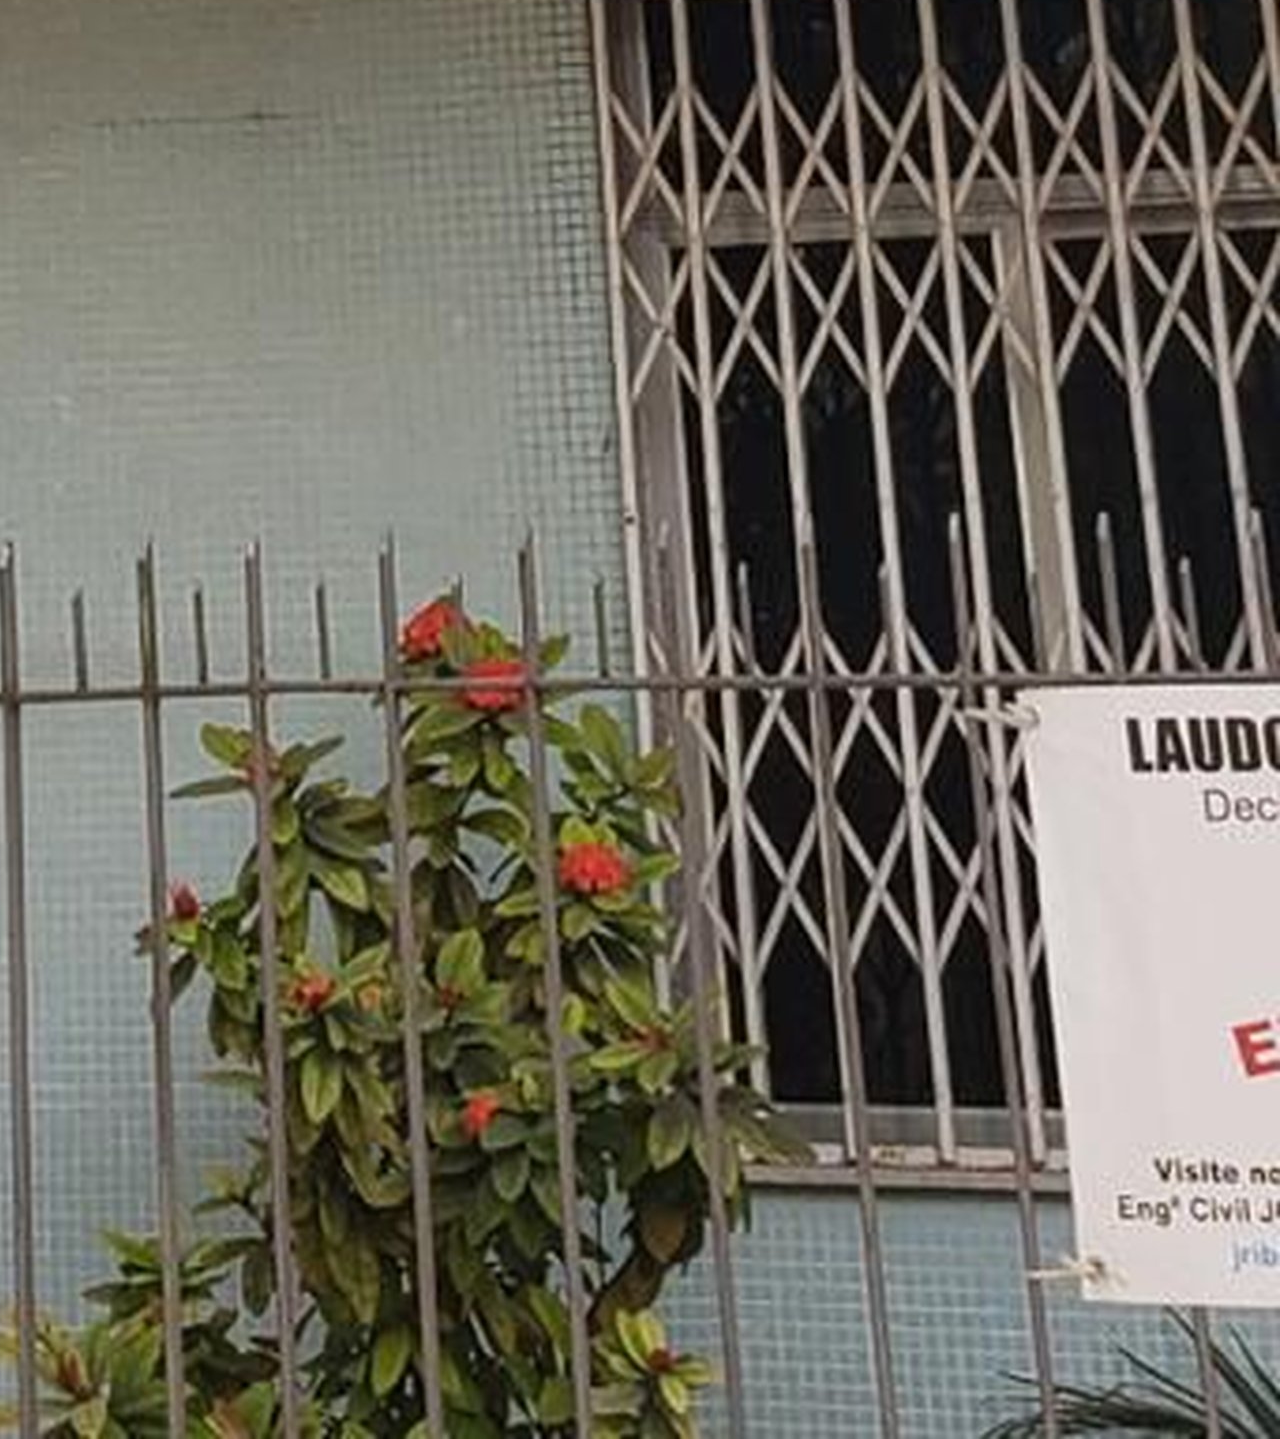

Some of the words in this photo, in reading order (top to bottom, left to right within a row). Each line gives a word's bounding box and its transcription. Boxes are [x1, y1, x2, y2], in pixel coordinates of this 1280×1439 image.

[1203, 788, 1279, 823] Dec
[1231, 1017, 1280, 1077] E
[1153, 1157, 1241, 1184] Visite
[1190, 1195, 1252, 1223] Civil
